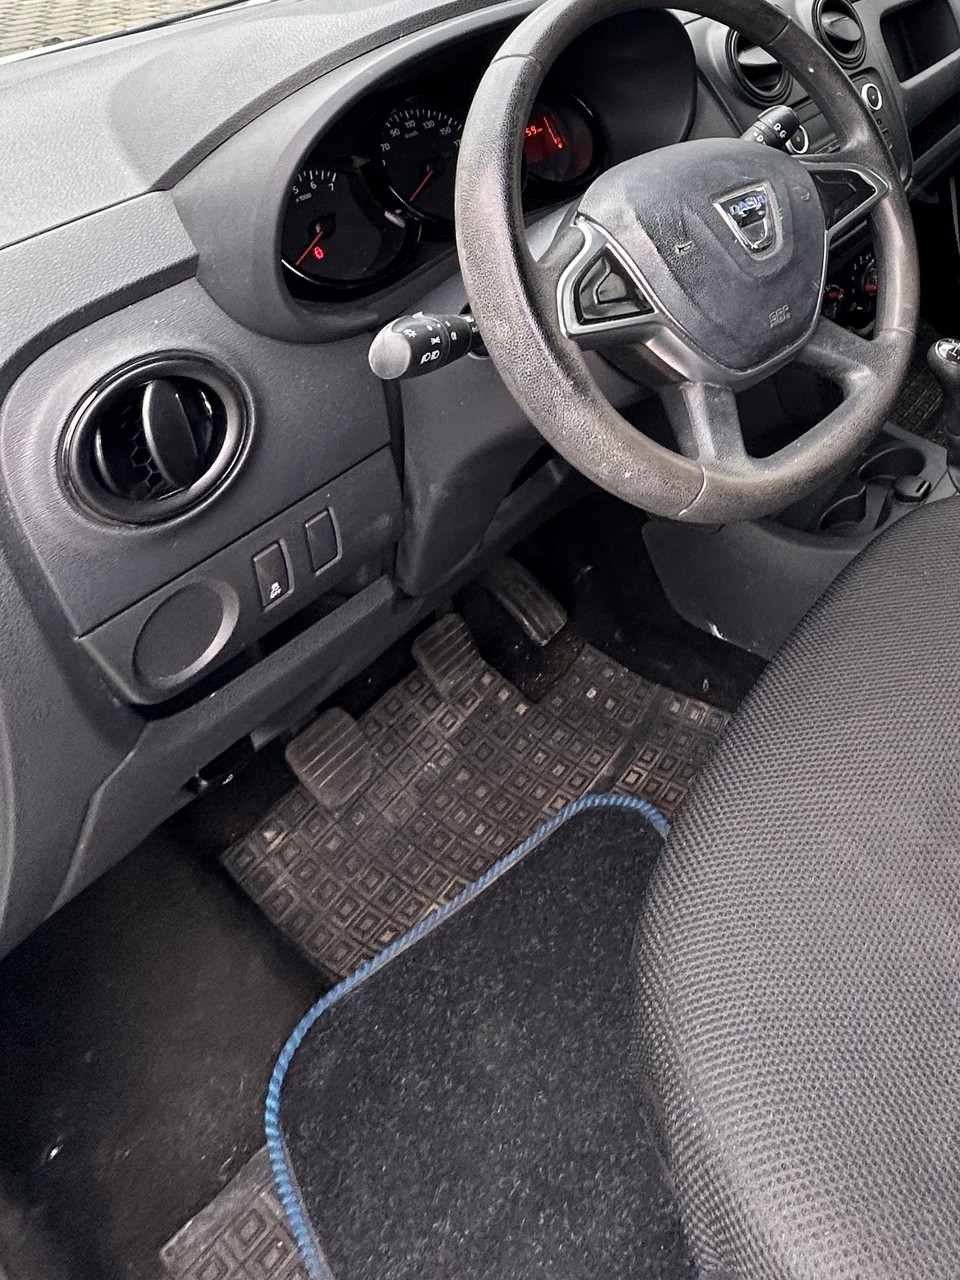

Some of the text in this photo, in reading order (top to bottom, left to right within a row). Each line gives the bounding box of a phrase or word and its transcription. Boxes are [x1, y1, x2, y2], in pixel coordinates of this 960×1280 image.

[405, 120, 416, 129] 110
[423, 120, 435, 129] 130
[390, 128, 400, 137] 90
[440, 126, 452, 135] 150
[380, 143, 390, 152] 70
[729, 194, 766, 216] DACIA
